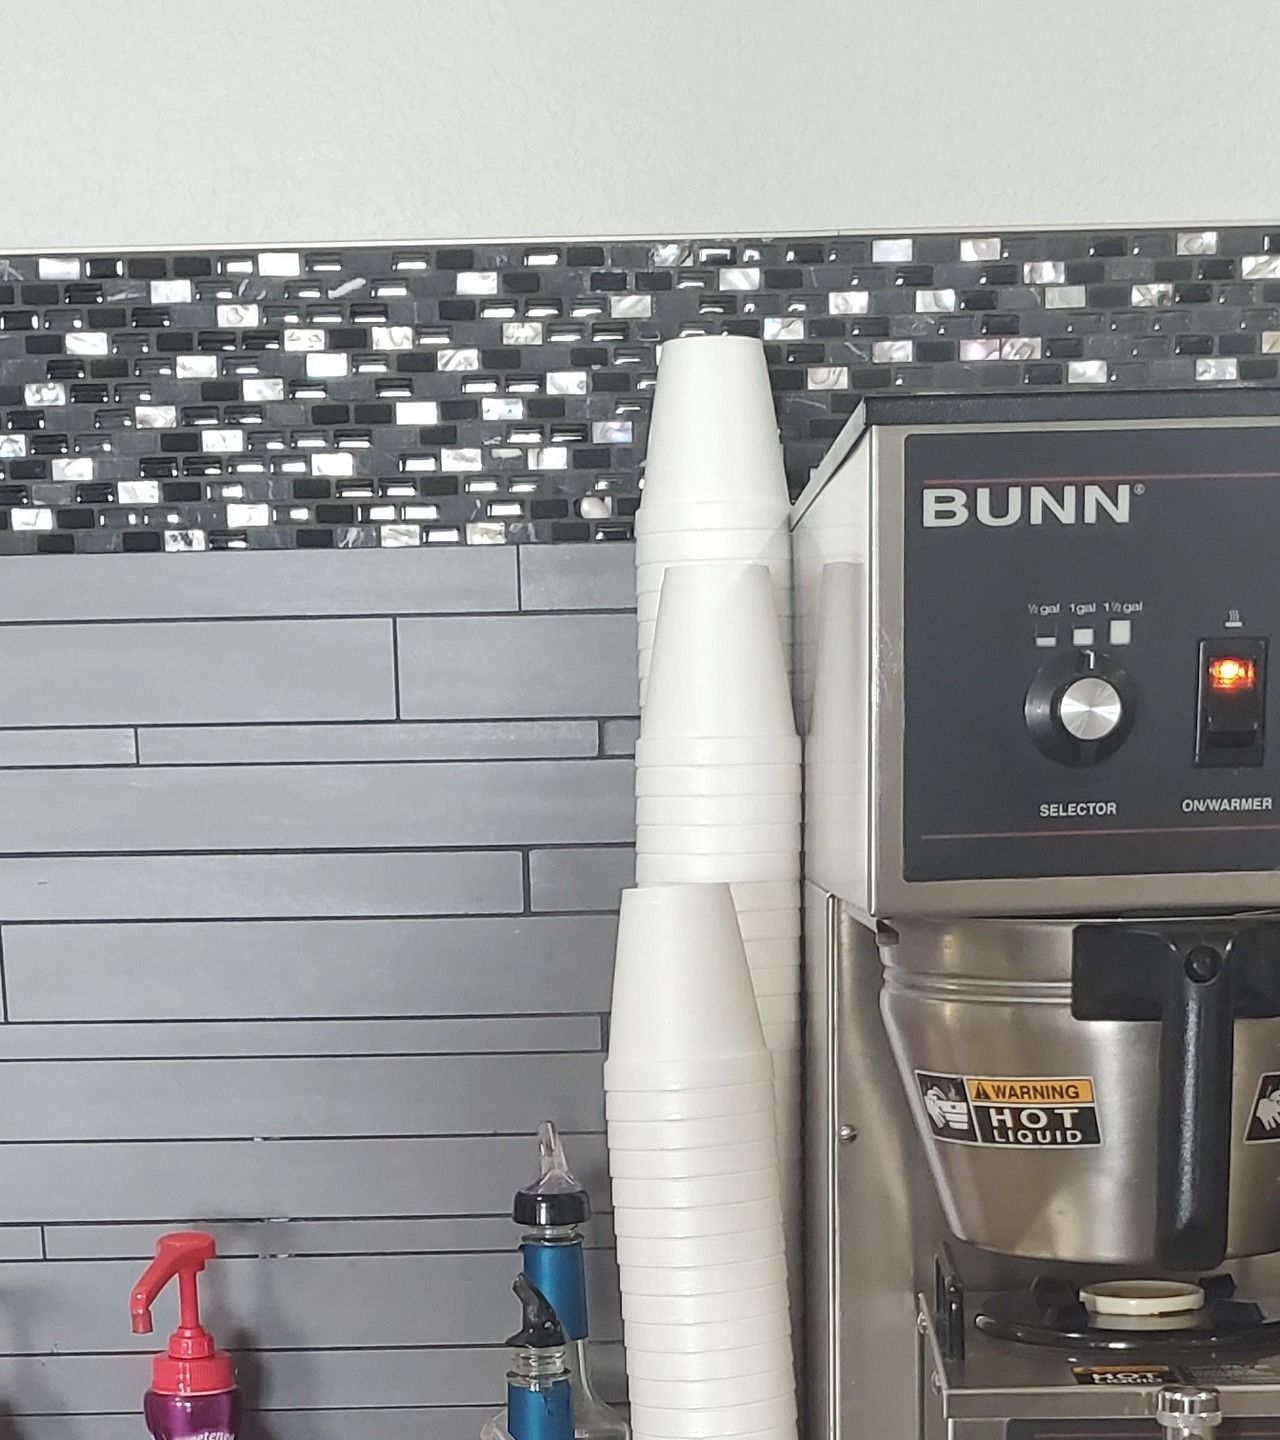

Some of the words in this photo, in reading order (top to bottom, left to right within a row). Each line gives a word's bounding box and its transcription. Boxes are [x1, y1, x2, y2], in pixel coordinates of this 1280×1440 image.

[922, 484, 1130, 528] BUNN
[1040, 603, 1060, 616] gal
[1076, 602, 1096, 615] gal
[1123, 601, 1143, 614] gal
[1039, 802, 1117, 817] SELECTOR
[1181, 796, 1273, 813] ON/WARMER
[991, 1084, 1080, 1100] WARNING
[989, 1108, 1079, 1128] HOT
[993, 1129, 1082, 1143] LIQUID
[1091, 1372, 1159, 1380] HOT
